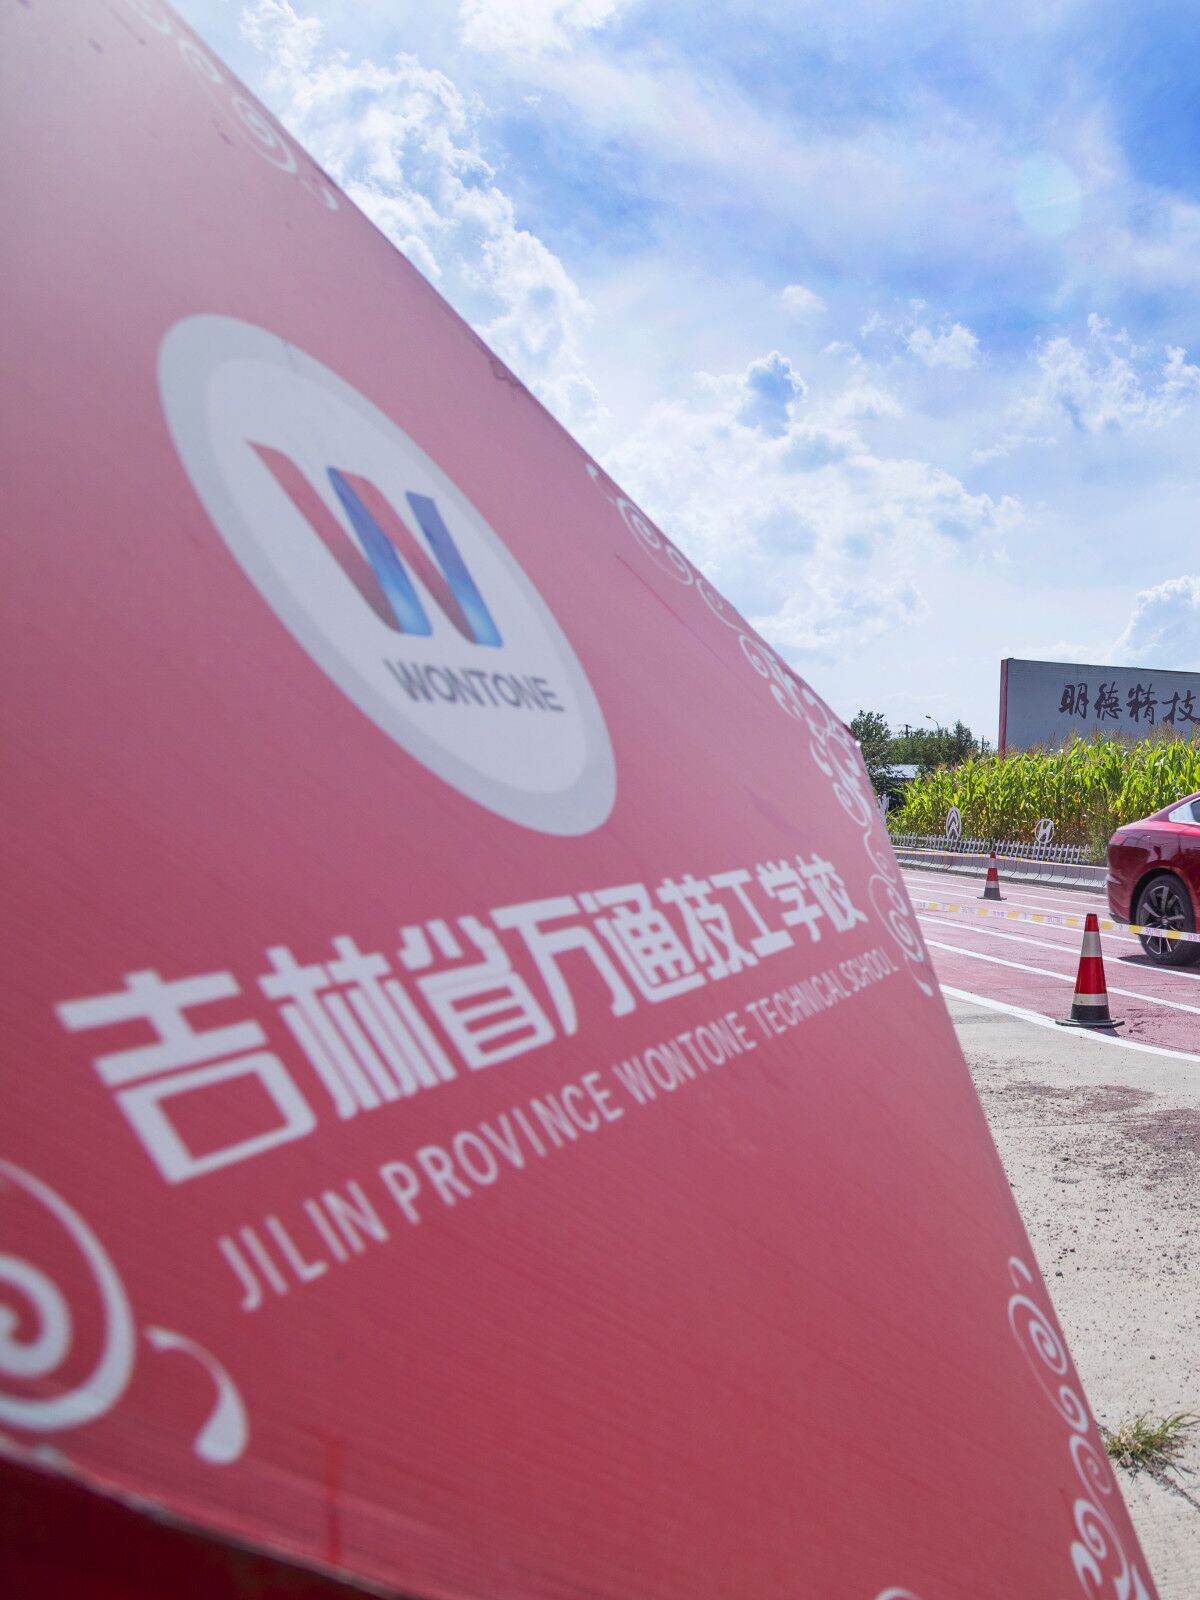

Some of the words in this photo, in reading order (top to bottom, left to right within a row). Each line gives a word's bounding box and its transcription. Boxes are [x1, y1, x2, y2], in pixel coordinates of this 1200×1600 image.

[383, 657, 565, 713] WONTONE
[55, 853, 869, 1185] 吉林省万通技工学校
[218, 1179, 390, 1313] JILIN
[379, 1071, 624, 1225] PROVINCE
[611, 1011, 758, 1105] WONTONE
[745, 967, 853, 1040] TECHNICAL
[839, 945, 899, 993] SCHOOL
